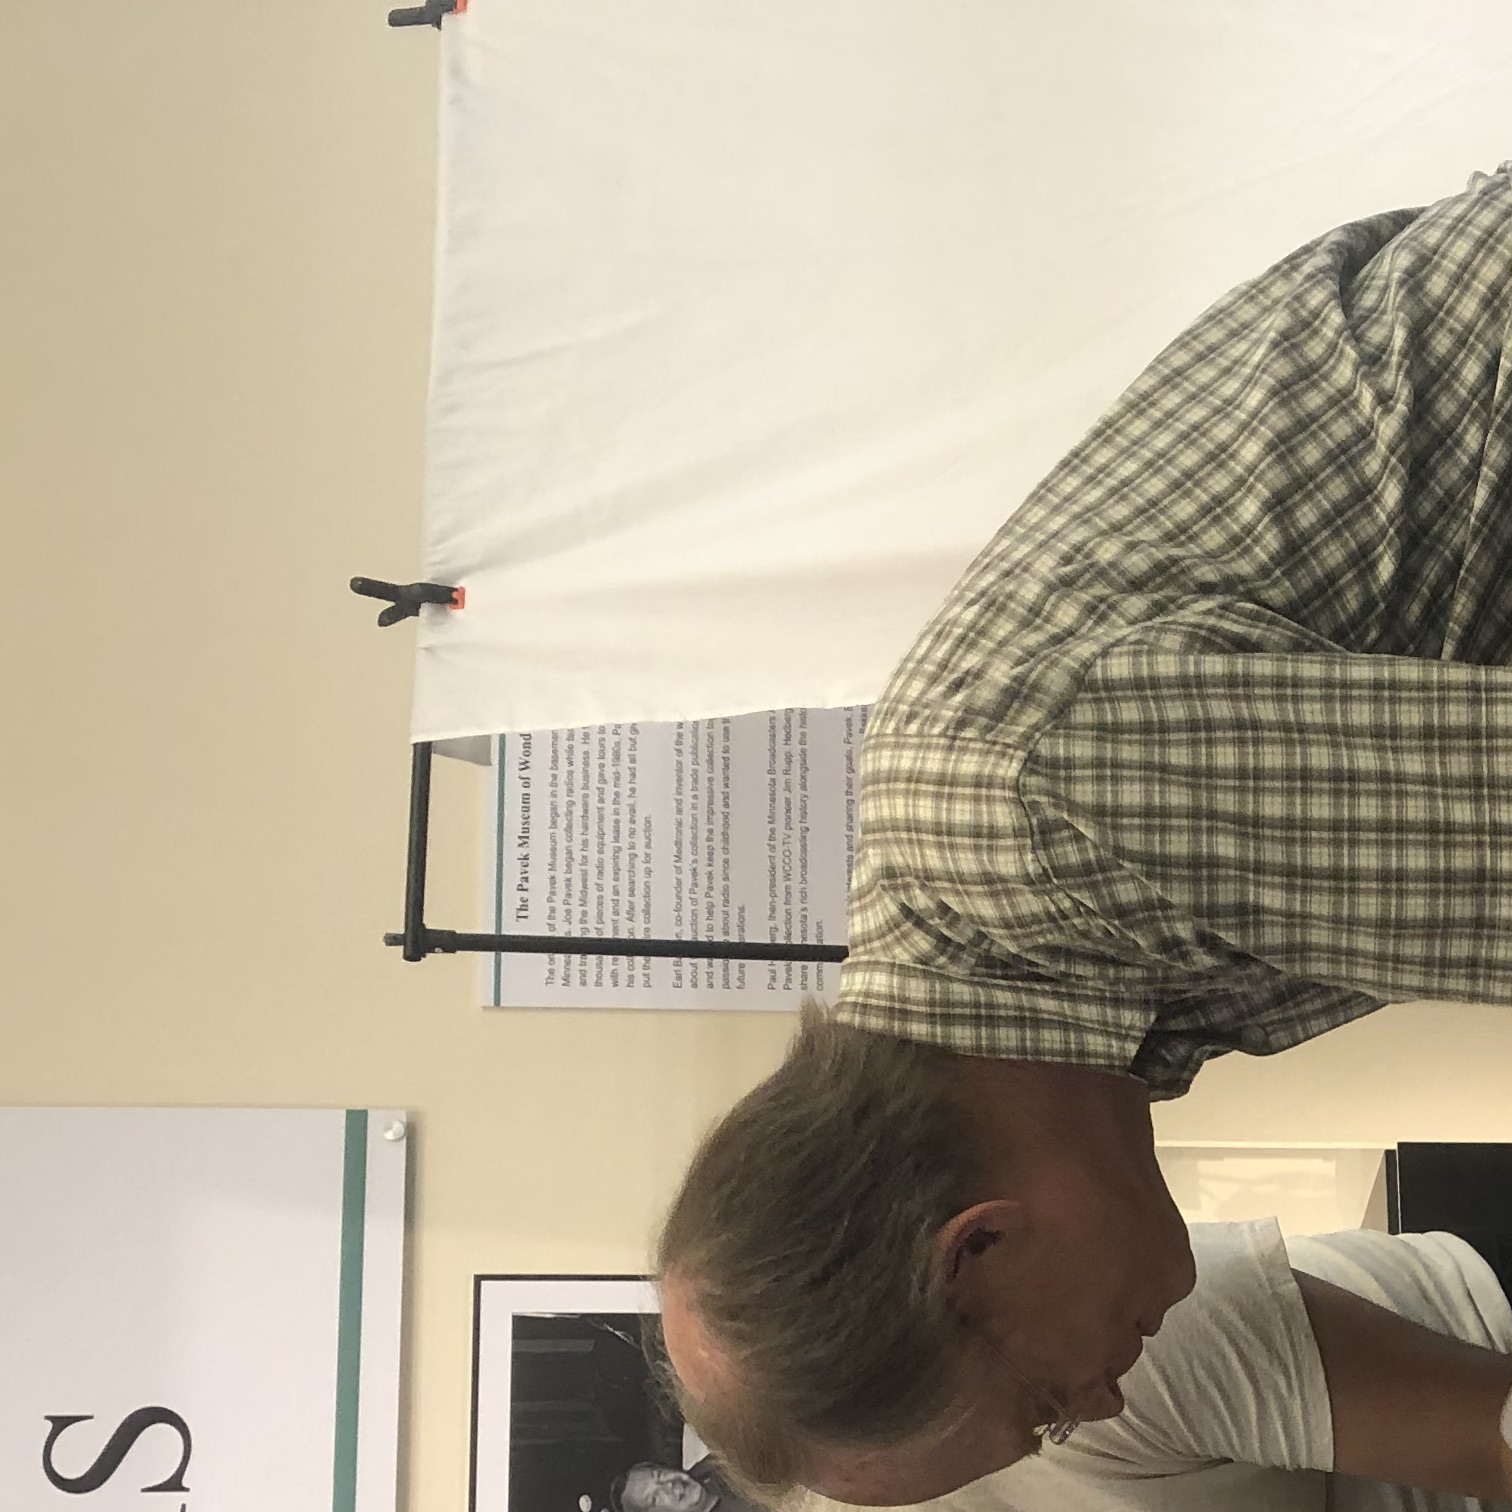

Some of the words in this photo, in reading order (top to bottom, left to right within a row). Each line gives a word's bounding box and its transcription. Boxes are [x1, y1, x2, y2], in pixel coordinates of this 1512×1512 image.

[580, 732, 590, 744] He
[596, 738, 606, 760] tours
[627, 737, 637, 751] but
[674, 732, 684, 746] the
[766, 716, 775, 775] Broadcasters
[797, 732, 807, 746] the
[564, 744, 574, 766] while
[674, 748, 684, 757] of
[705, 732, 715, 774] collection
[720, 745, 730, 754] to
[598, 762, 608, 784] gave
[626, 768, 636, 784] had
[674, 760, 684, 796] inventor
[689, 768, 699, 792] trade
[720, 756, 730, 789] wanted
[797, 748, 809, 791] alongside
[518, 775, 530, 788] of
[548, 774, 558, 788] the
[564, 770, 574, 798] radios
[782, 779, 792, 794] Jim
[843, 777, 853, 796] their
[548, 790, 558, 798] in
[595, 787, 605, 804] and
[611, 791, 621, 805] the
[626, 787, 636, 798] he
[704, 776, 717, 825] impressive
[720, 792, 730, 808] and
[766, 778, 775, 824] Minnesota
[548, 800, 560, 829] began
[579, 793, 590, 835] hardware
[611, 808, 621, 816] in
[674, 798, 684, 816] and
[782, 797, 794, 830] pioneer
[797, 794, 809, 824] history
[843, 799, 855, 832] sharing
[518, 793, 530, 848] Museum
[563, 800, 576, 843] collecting
[595, 806, 607, 854] equipment
[611, 819, 621, 843] lease
[628, 828, 636, 839] no
[673, 818, 683, 862] Medtronic
[689, 814, 699, 856] collection
[704, 828, 714, 842] the
[720, 812, 730, 855] childhood
[766, 828, 776, 841] the
[843, 835, 853, 852] and
[547, 832, 557, 872] Museum
[579, 838, 589, 852] his
[626, 842, 636, 850] to
[704, 845, 716, 867] keep
[766, 843, 776, 853] of
[797, 826, 809, 884] broadcasting
[563, 846, 575, 874] began
[579, 855, 589, 866] for
[610, 846, 623, 882] expiring
[642, 852, 652, 864] for
[782, 832, 792, 882] WCCO-TV
[517, 852, 530, 892] Pavek
[594, 858, 604, 880] radio
[625, 853, 638, 898] searching
[644, 866, 654, 878] up
[673, 865, 683, 874] of
[688, 859, 698, 894] Pavek's
[720, 858, 730, 882] since
[546, 875, 557, 903] Pavek
[562, 876, 573, 906] Pavek
[578, 869, 589, 906] Midwest
[594, 882, 604, 892] of
[612, 885, 620, 896] an
[704, 870, 714, 898] Pavek
[766, 855, 778, 921] then-president
[782, 885, 792, 905] from
[641, 882, 651, 924] collection
[673, 878, 683, 926] co-founder
[688, 897, 698, 906] of
[720, 885, 730, 907] radio
[798, 888, 807, 904] rich
[516, 896, 529, 922] The
[546, 906, 556, 920] the
[562, 909, 572, 925] Joe
[578, 910, 588, 924] the
[594, 894, 606, 924] pieces
[610, 899, 620, 916] and
[625, 900, 635, 922] After
[704, 902, 716, 920] help
[546, 922, 556, 932] of
[704, 923, 714, 932] to
[720, 911, 730, 936] about
[545, 968, 555, 986] The
[577, 970, 587, 987] and
[609, 969, 619, 988] with
[625, 974, 635, 988] his
[641, 973, 653, 988] put
[672, 970, 682, 988] Earl
[688, 963, 698, 988] about
[704, 972, 714, 988] and
[735, 964, 745, 989] future
[766, 970, 776, 990] Paul
[798, 965, 807, 990] share
